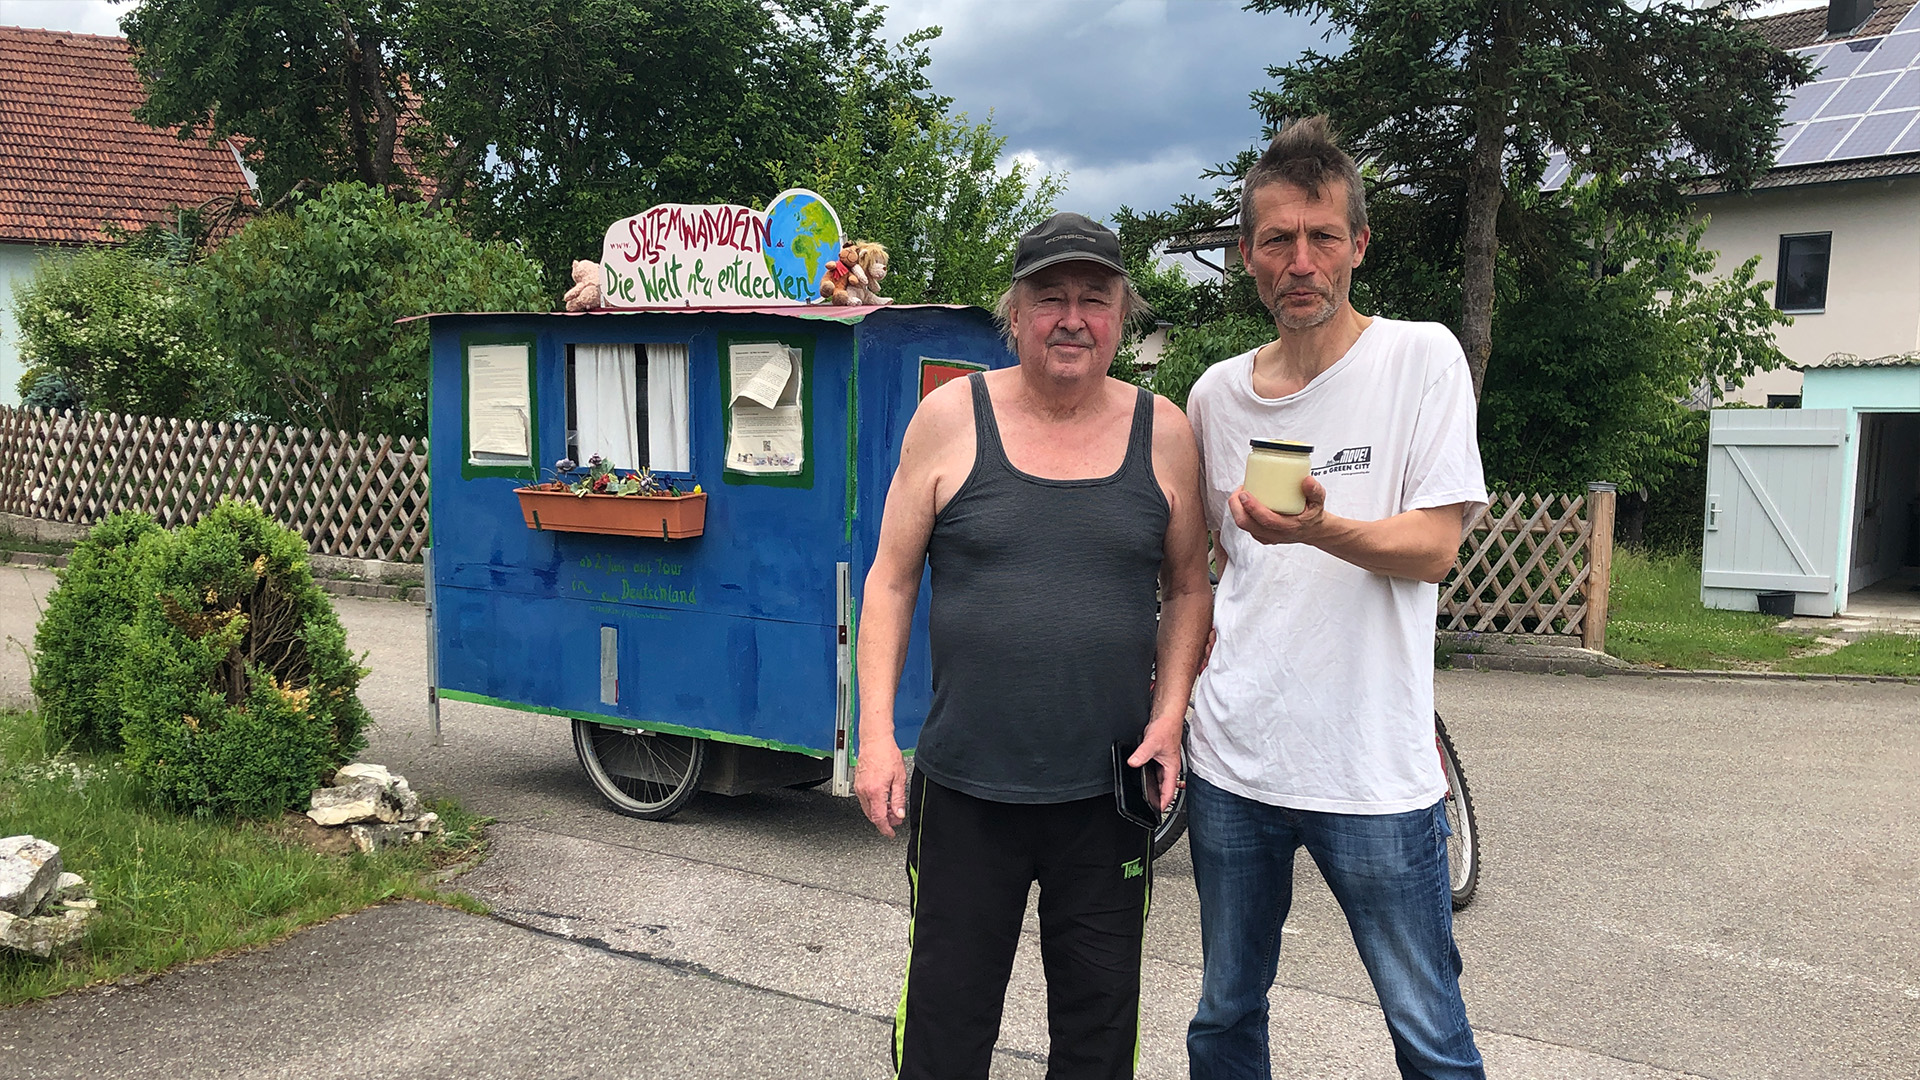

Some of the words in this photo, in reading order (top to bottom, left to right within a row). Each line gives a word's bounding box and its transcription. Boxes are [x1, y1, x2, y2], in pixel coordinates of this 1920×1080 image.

[604, 261, 636, 303] Die
[638, 253, 683, 304] Welt
[687, 258, 714, 299] neu
[717, 254, 816, 300] entdecken
[1340, 448, 1368, 464] MOVE!
[1329, 464, 1352, 474] GREEN
[656, 557, 684, 576] Tour
[572, 574, 593, 595] in
[621, 578, 697, 605] Deutschland
